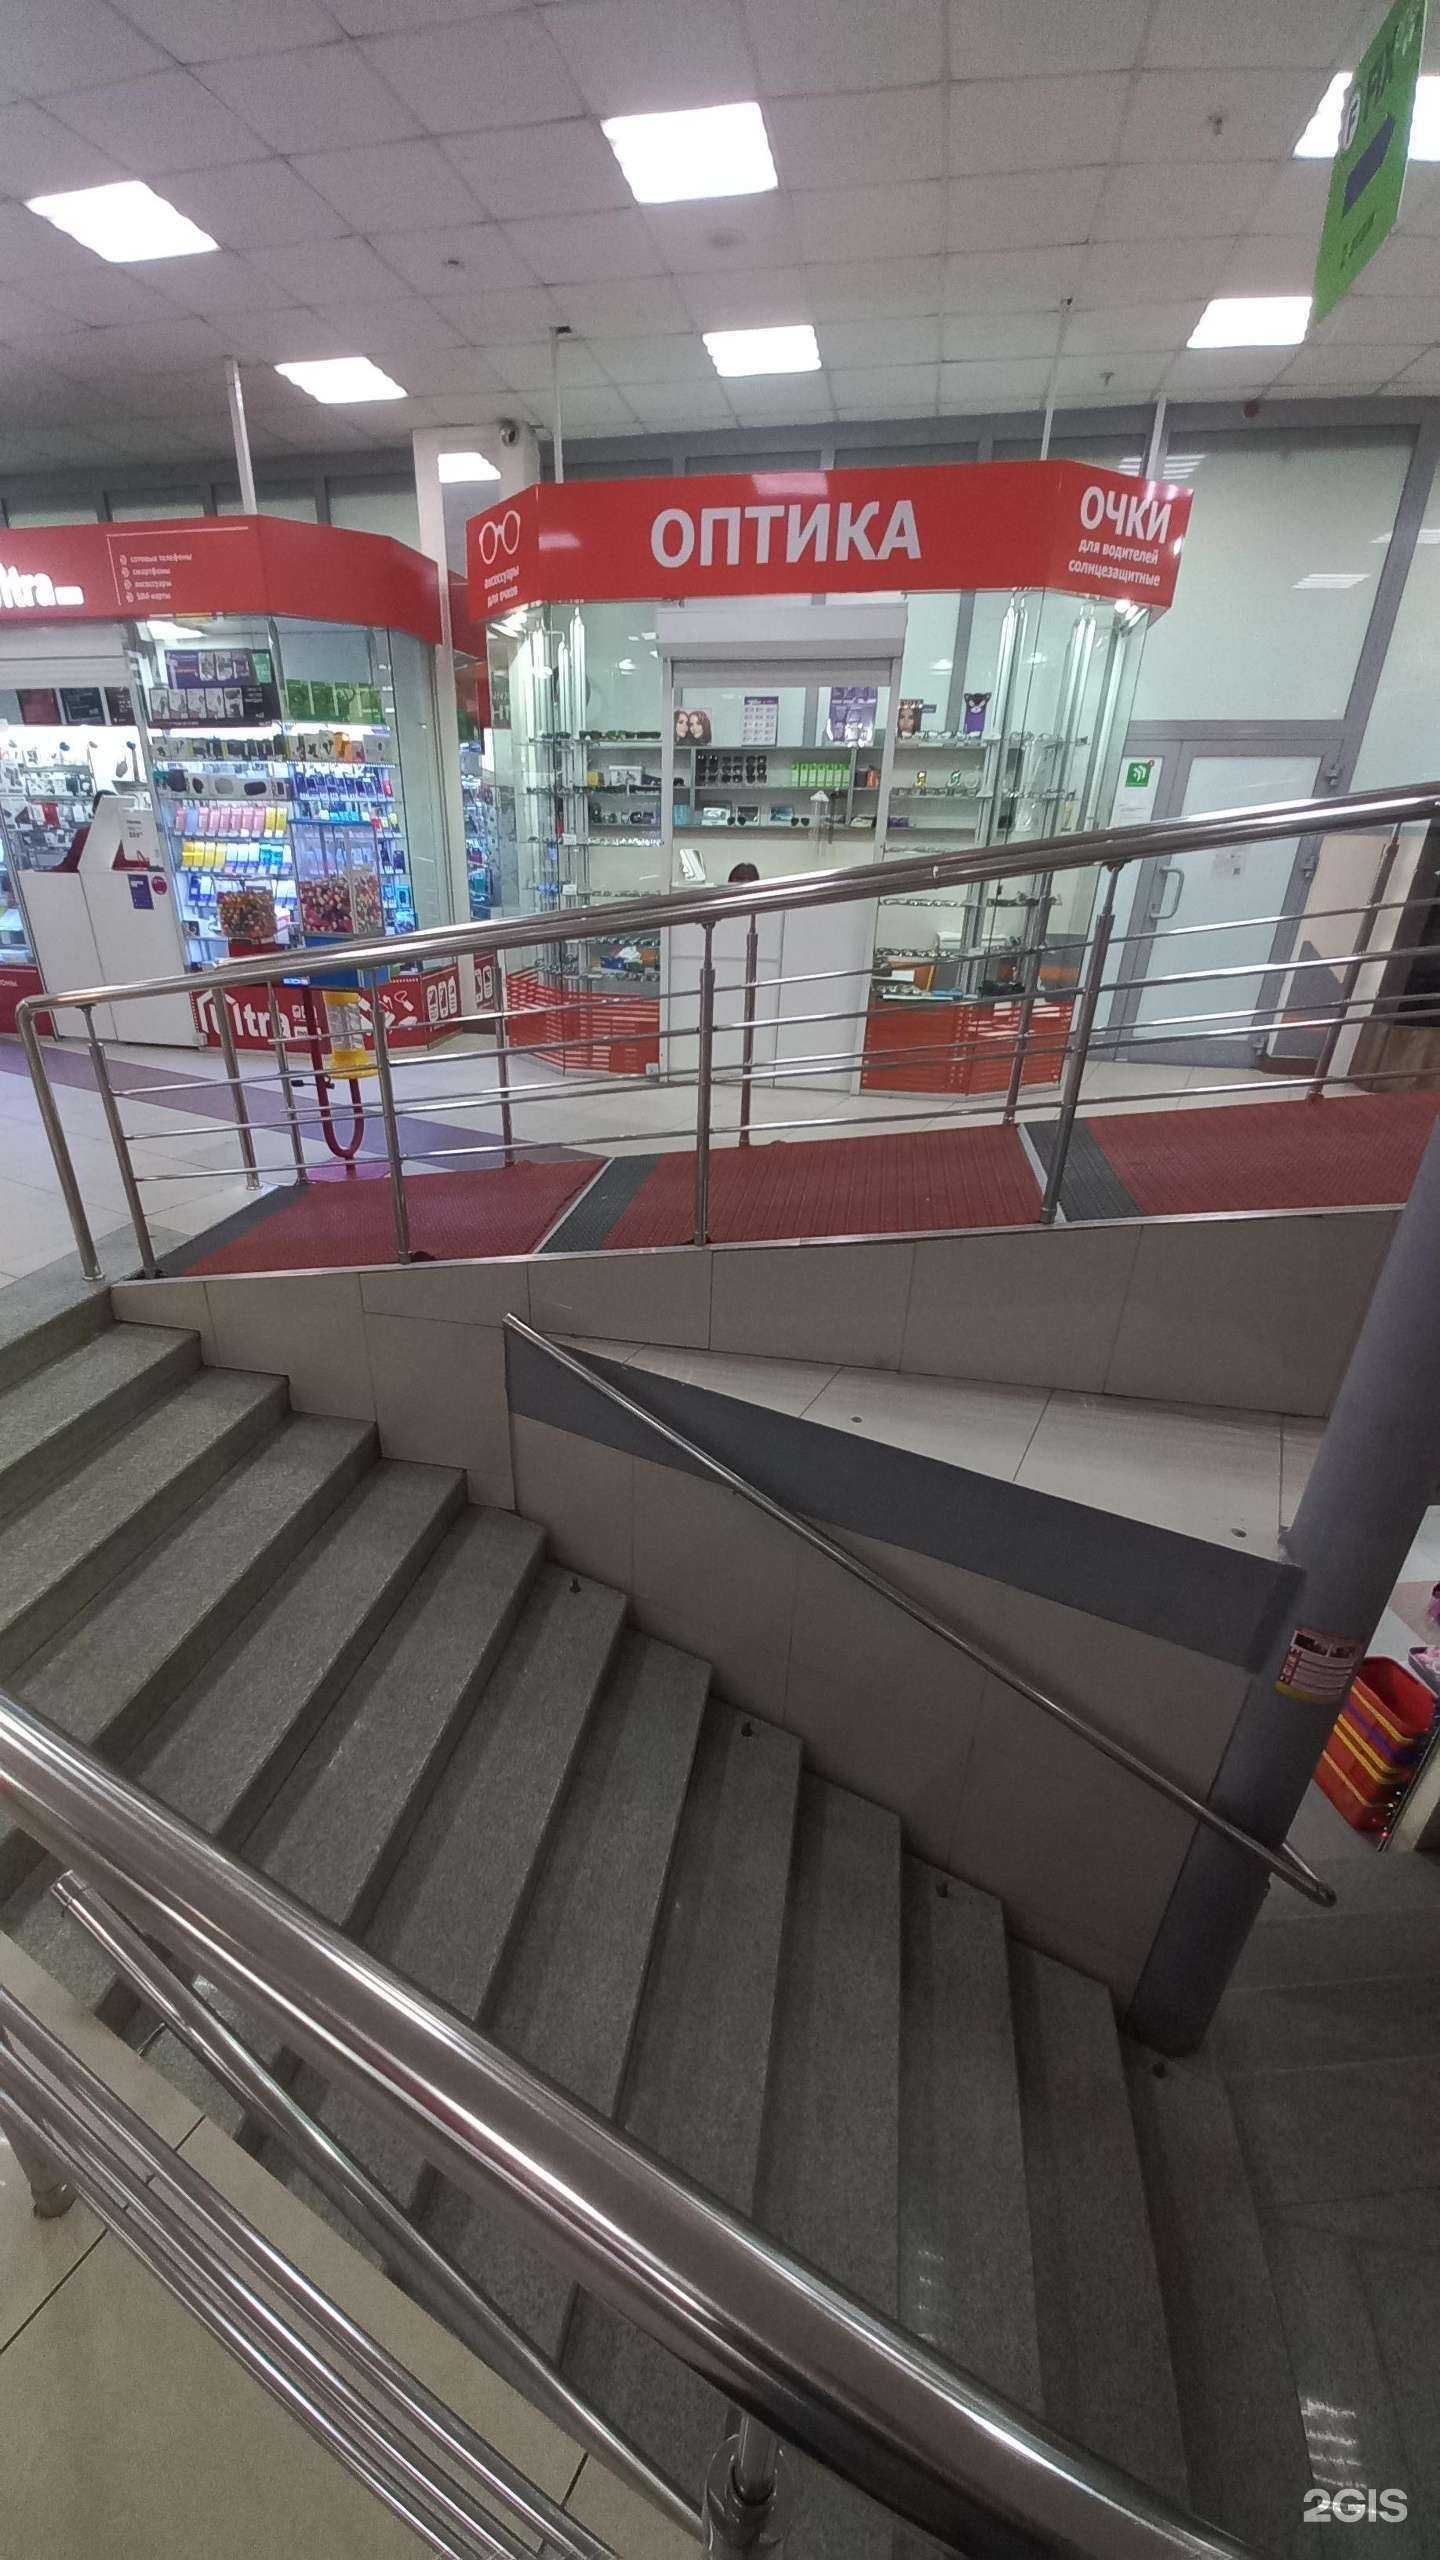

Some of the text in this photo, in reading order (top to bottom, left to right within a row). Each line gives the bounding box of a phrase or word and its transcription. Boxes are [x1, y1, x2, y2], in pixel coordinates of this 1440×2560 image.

[651, 499, 922, 568] ОПТИКА
[1081, 485, 1172, 544] ОЧКИ
[1067, 559, 1161, 587] солнцезащитные
[1078, 539, 1160, 565] для водителей
